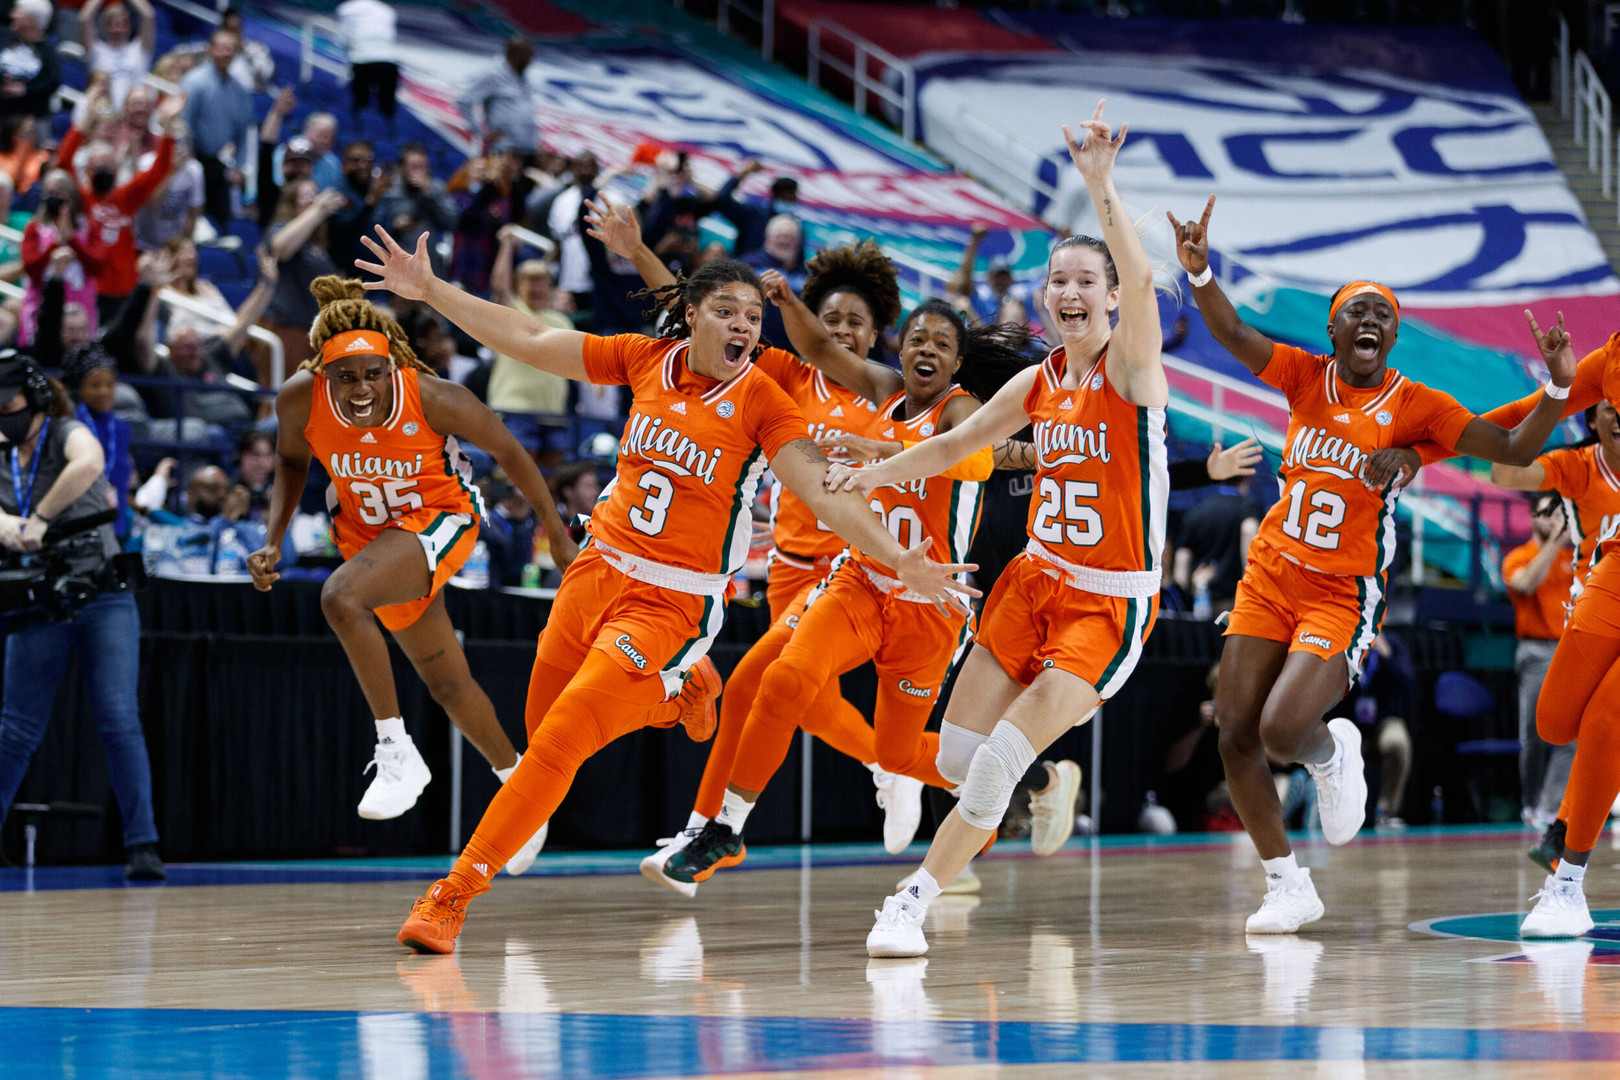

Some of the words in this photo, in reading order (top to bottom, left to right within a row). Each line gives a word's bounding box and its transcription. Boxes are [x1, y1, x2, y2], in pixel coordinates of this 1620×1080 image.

[1034, 126, 1558, 215] ACC
[330, 451, 423, 481] Miami
[621, 412, 722, 485] Miami
[1033, 419, 1111, 469] Miami
[1286, 425, 1374, 488] Miam
[349, 480, 424, 526] 35
[628, 469, 674, 537] 3
[1032, 476, 1104, 546] 25
[1282, 479, 1347, 550] 12
[614, 634, 648, 670] Canes
[1298, 631, 1332, 650] Canes
[898, 679, 932, 699] Canes
